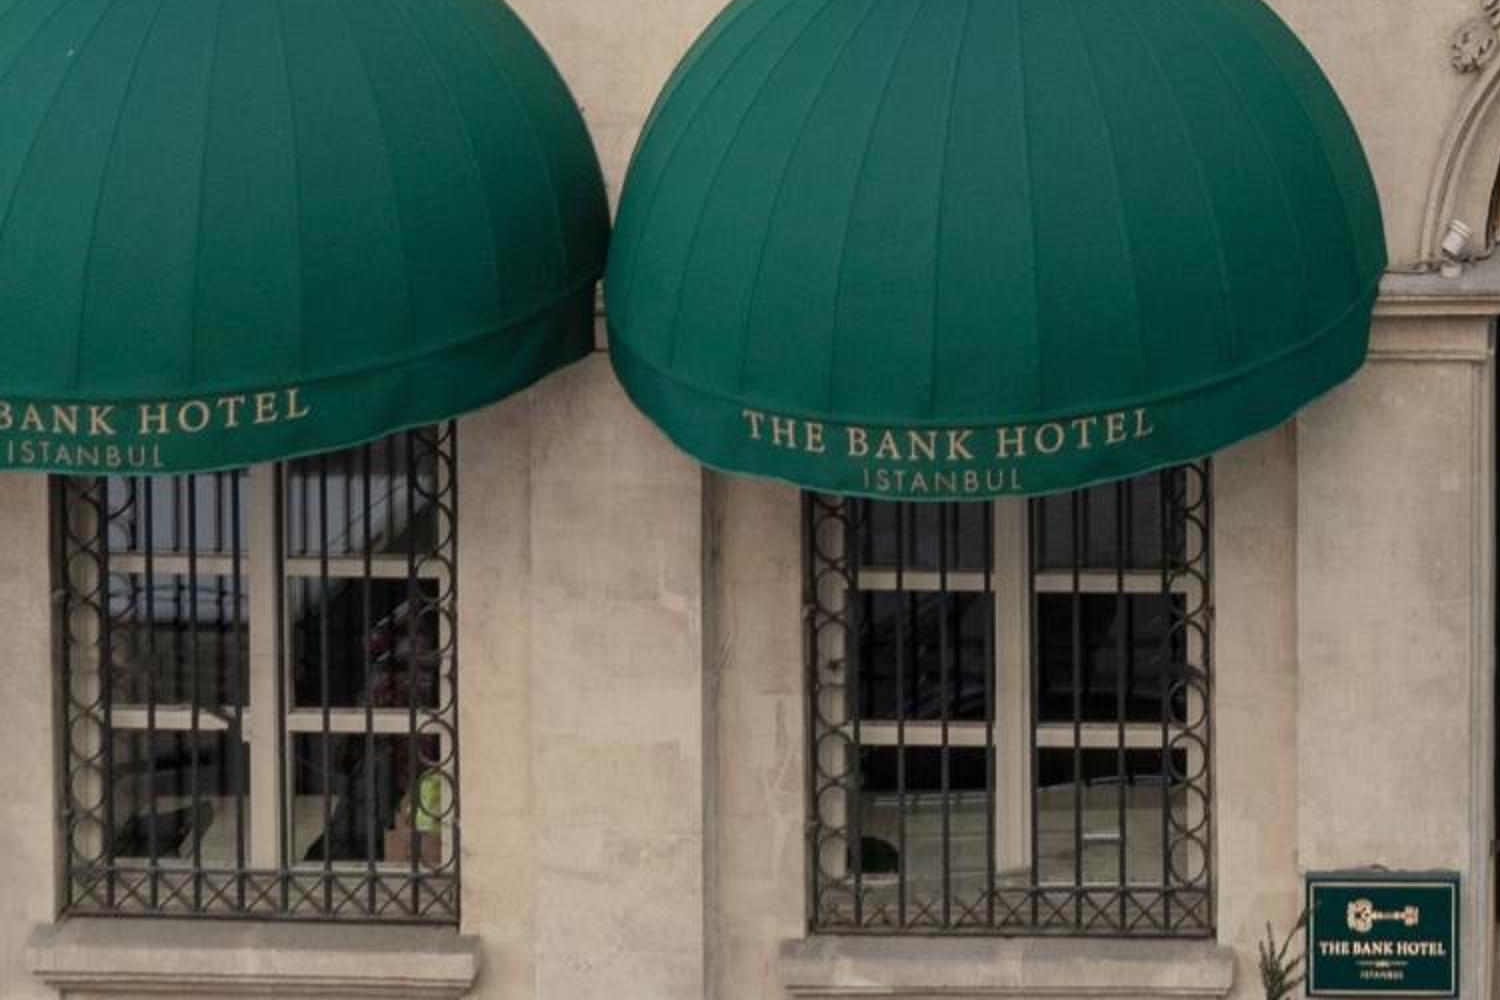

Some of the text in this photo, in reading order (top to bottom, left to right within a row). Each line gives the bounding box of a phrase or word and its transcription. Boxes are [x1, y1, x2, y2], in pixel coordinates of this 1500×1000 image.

[0, 388, 311, 435] BANK HOTEL
[742, 407, 1154, 460] THE BANK HOTEL
[8, 439, 164, 468] ISTANBUL
[863, 468, 1023, 493] ISTANBUL
[1319, 941, 1446, 956] THE BANK HOTEL
